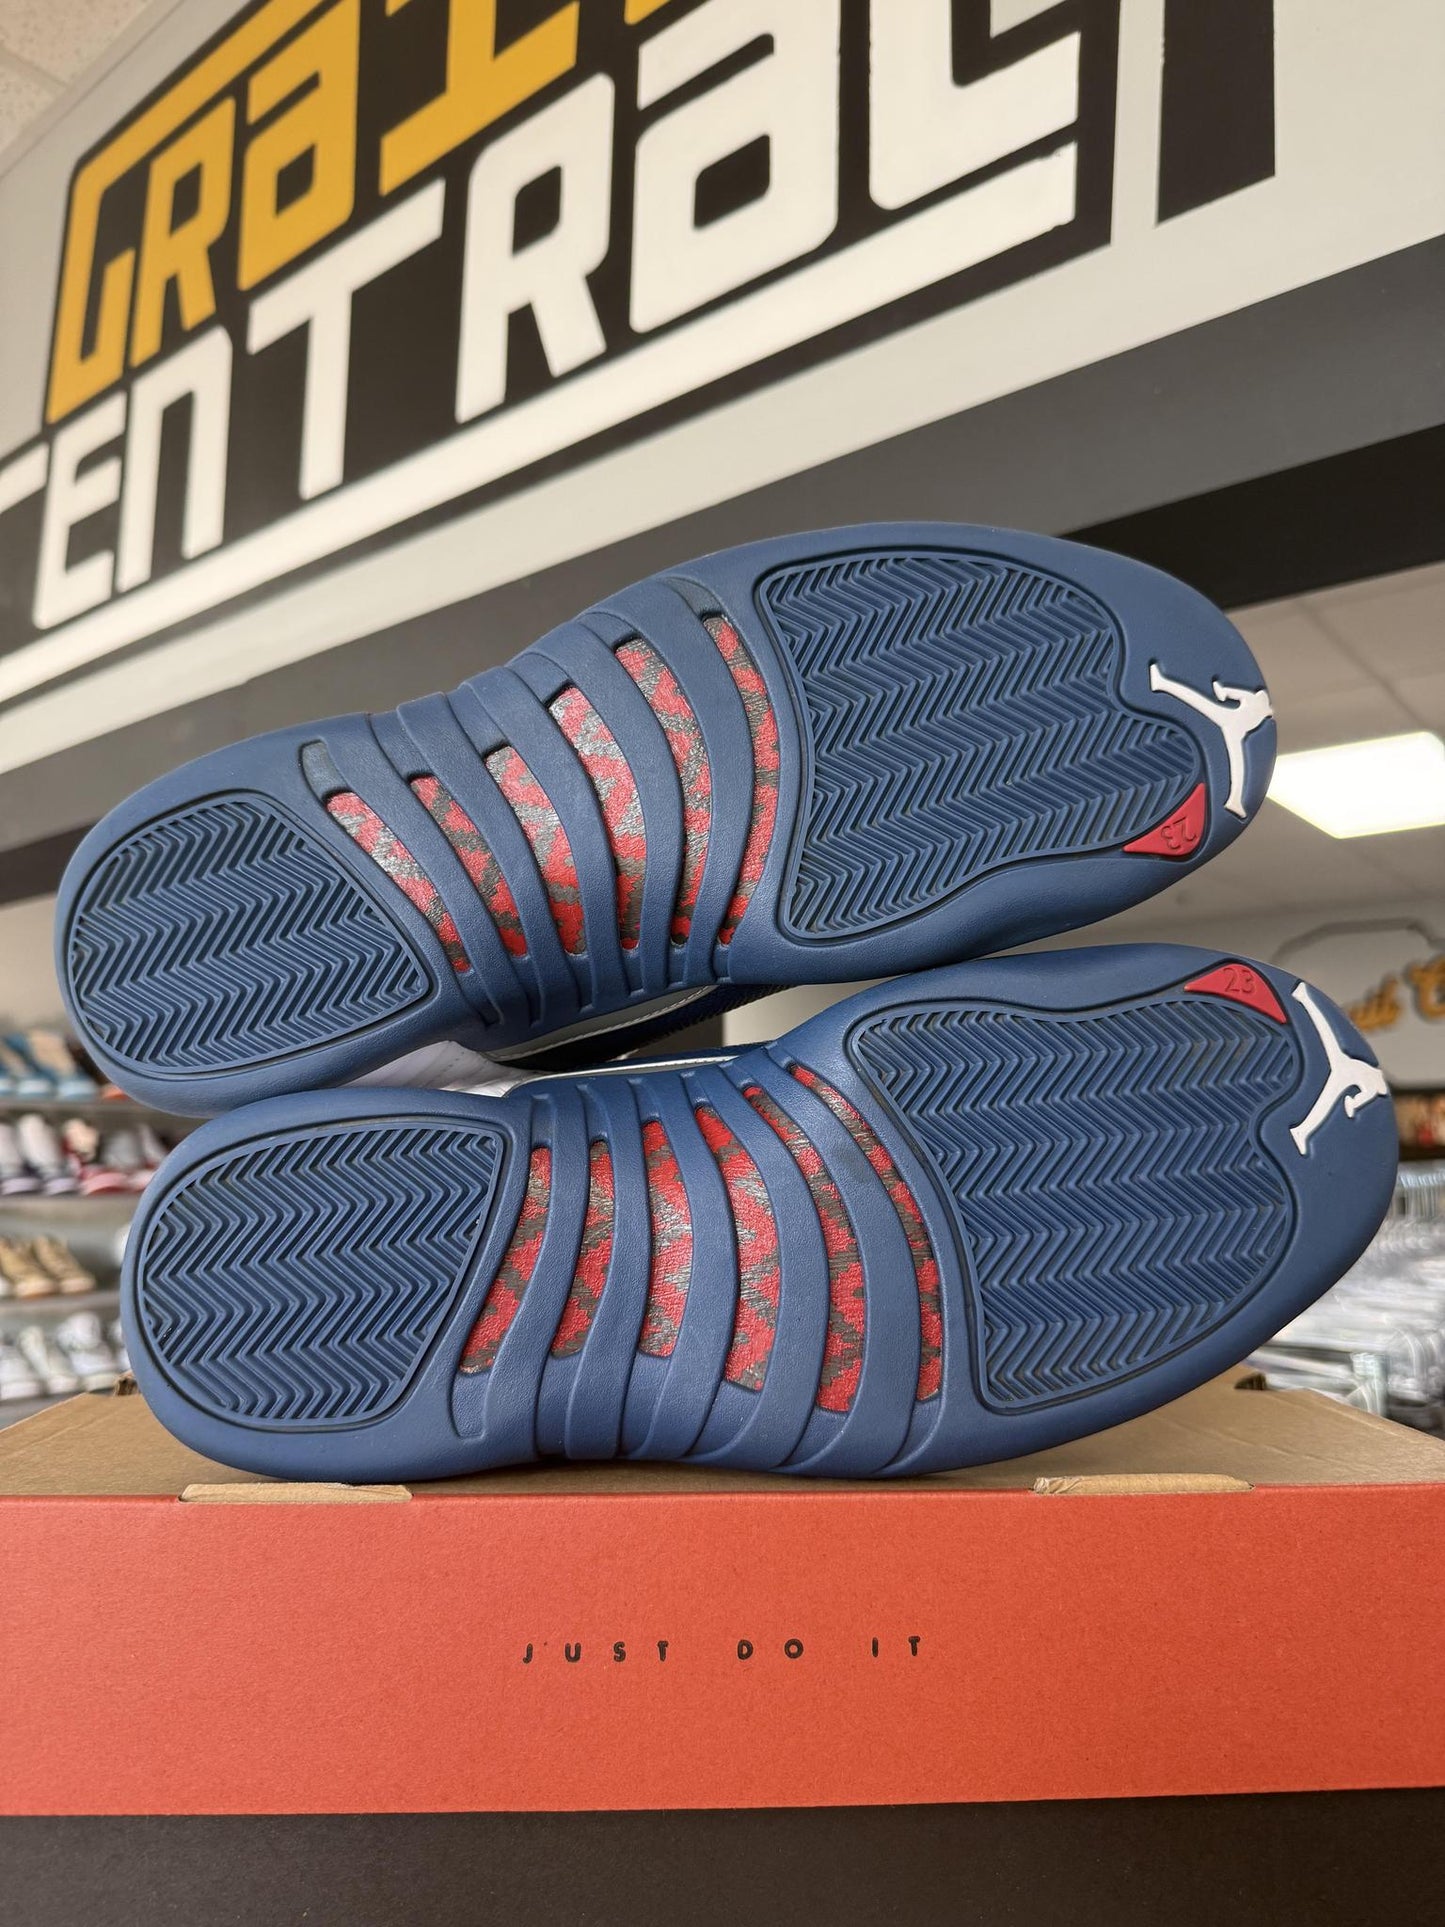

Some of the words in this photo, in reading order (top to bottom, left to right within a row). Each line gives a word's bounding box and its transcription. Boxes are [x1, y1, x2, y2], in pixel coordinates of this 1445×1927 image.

[1160, 816, 1198, 850] 23
[1222, 967, 1256, 994] 23
[522, 1640, 669, 1664] JUST
[737, 1638, 804, 1661] DO
[871, 1635, 921, 1658] IT
